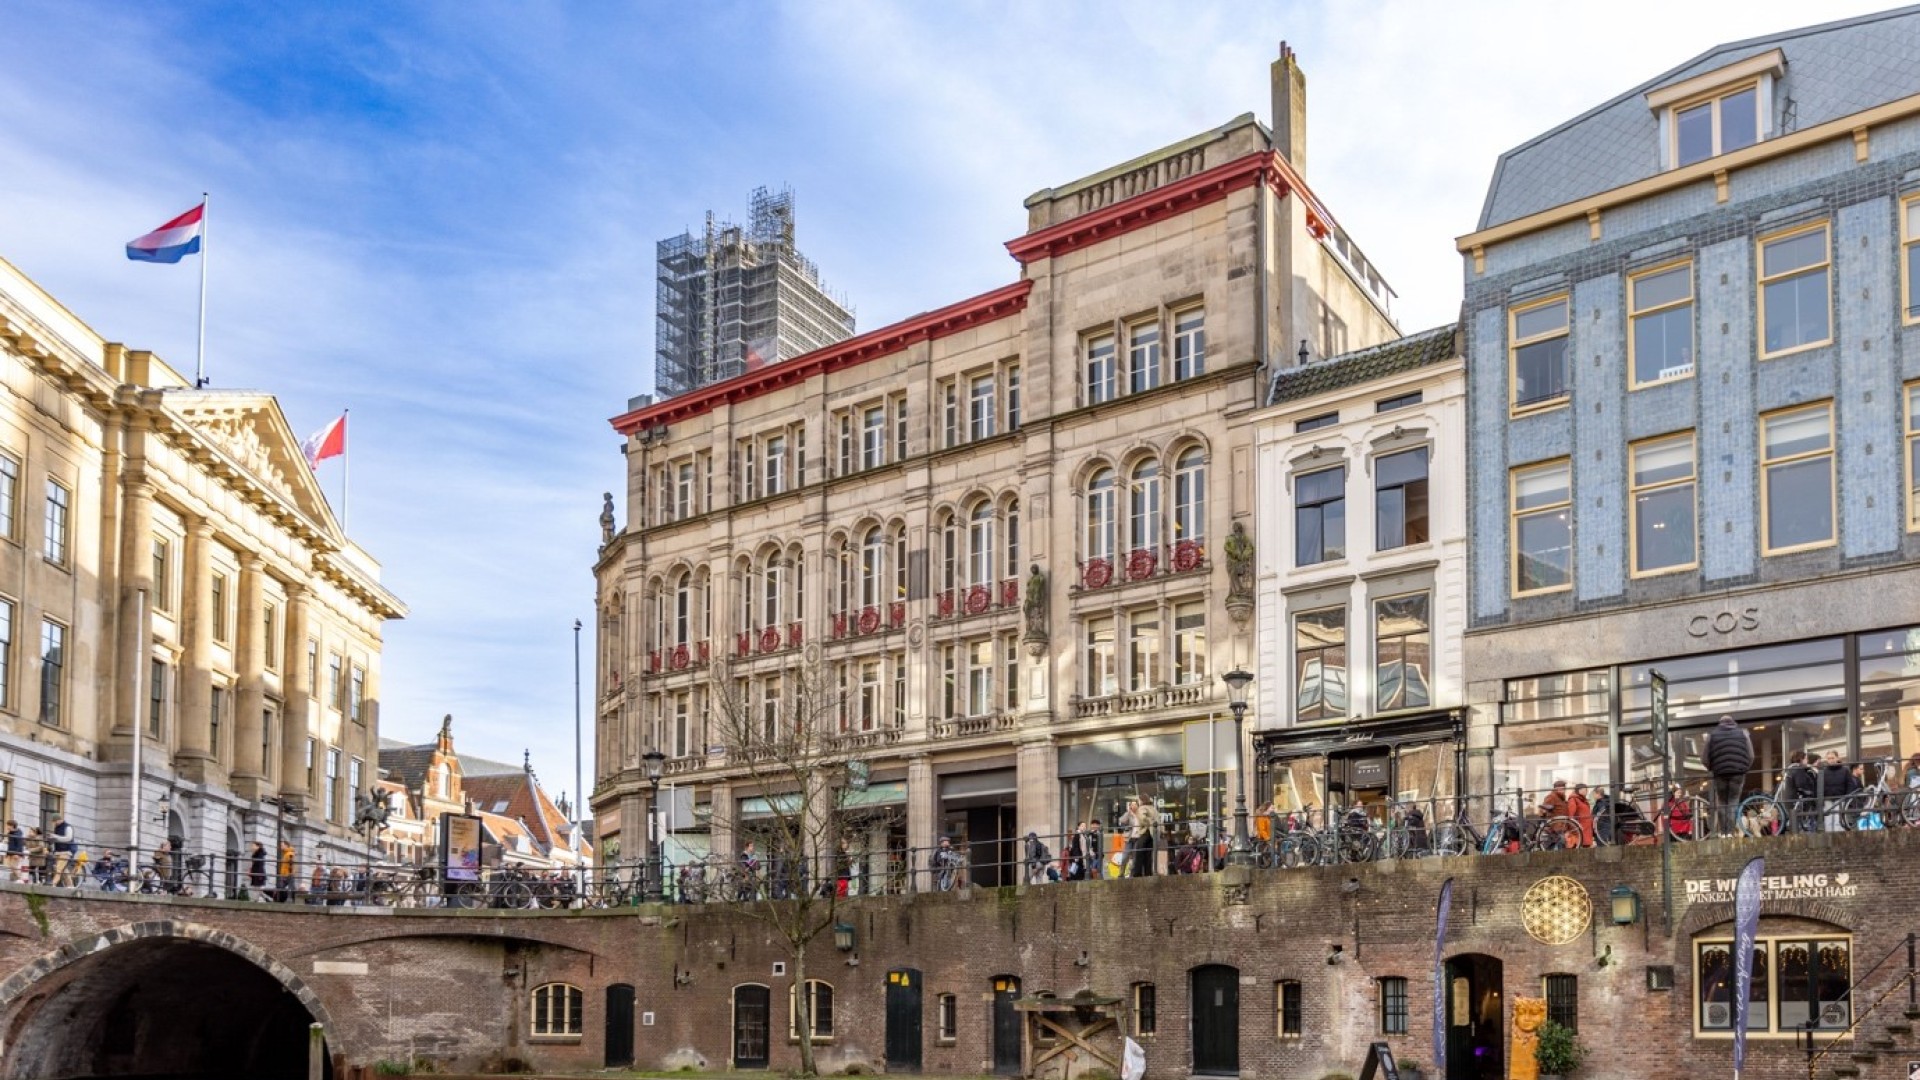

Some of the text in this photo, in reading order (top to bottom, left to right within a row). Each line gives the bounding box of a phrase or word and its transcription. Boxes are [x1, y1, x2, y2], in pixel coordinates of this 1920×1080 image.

[1687, 607, 1759, 638] COS
[1685, 874, 1828, 893] DE WFELING
[1775, 886, 1823, 900] MAGISCH
[1826, 884, 1858, 898] HART
